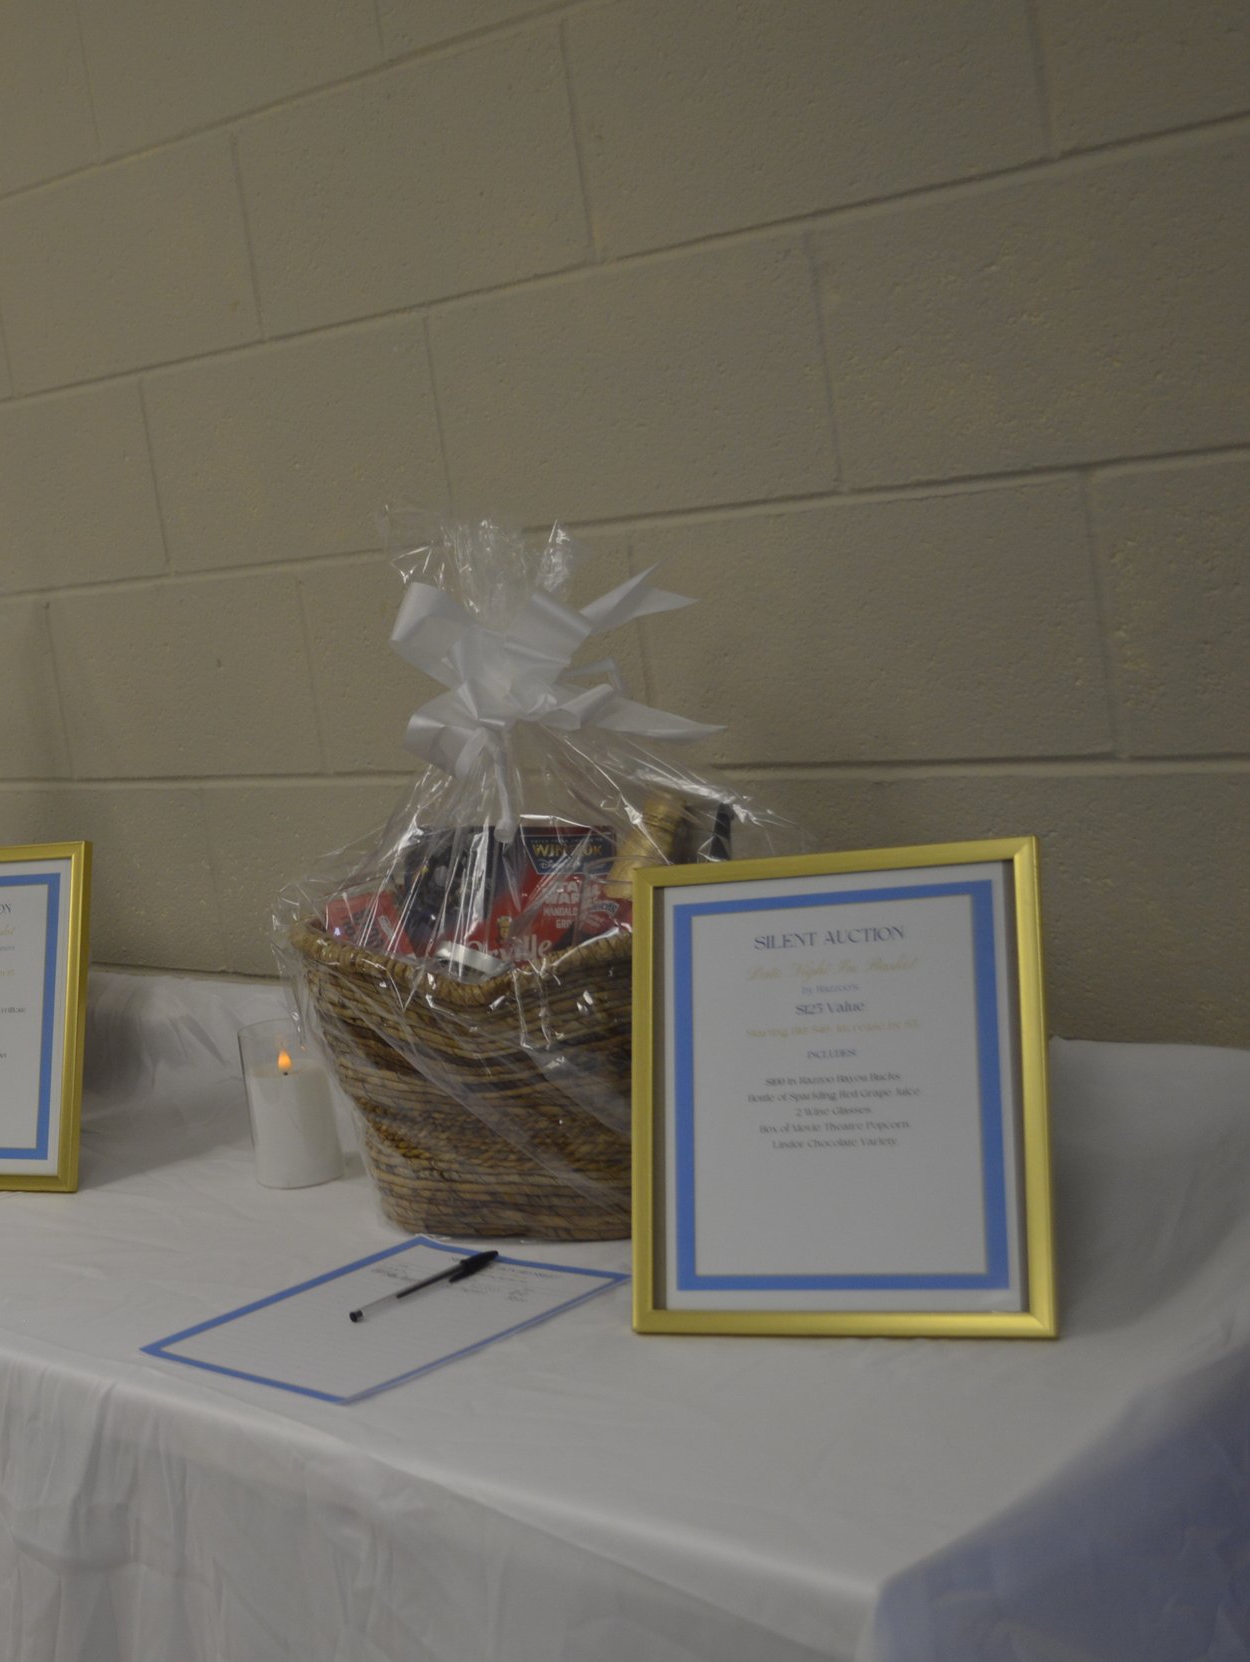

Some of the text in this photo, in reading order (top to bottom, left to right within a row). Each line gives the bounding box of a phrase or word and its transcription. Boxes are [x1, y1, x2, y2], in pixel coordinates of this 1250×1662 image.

[754, 926, 904, 951] SILENT AUCTION
[795, 1000, 865, 1016] $125 Value
[838, 1089, 858, 1100] Red
[860, 1088, 892, 1101] Grape
[895, 1087, 921, 1097] Juice
[832, 1105, 872, 1115] Glasses
[806, 1137, 858, 1149] Chocolate
